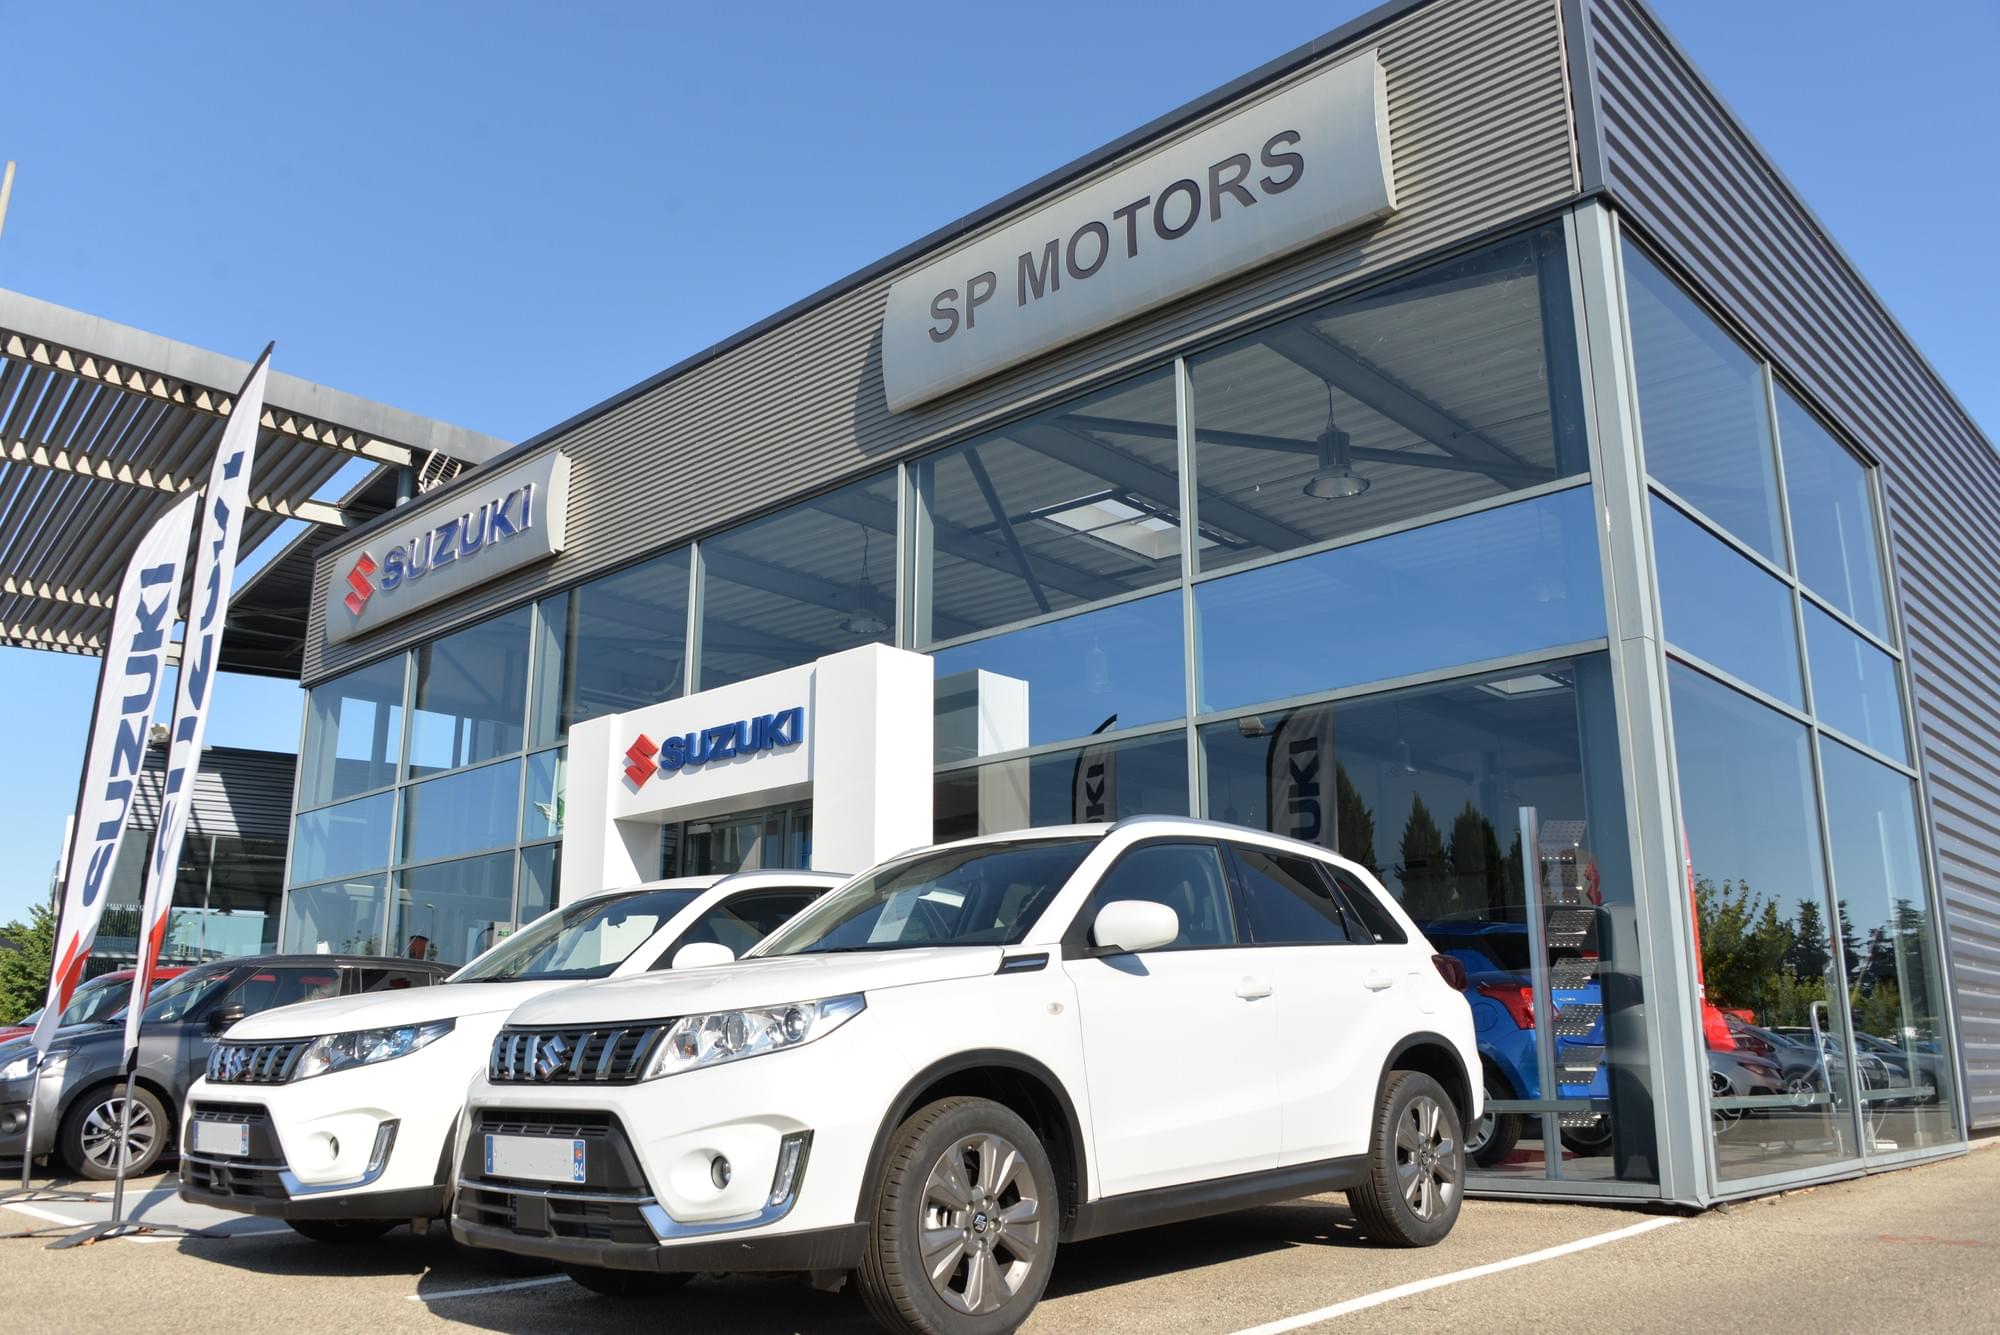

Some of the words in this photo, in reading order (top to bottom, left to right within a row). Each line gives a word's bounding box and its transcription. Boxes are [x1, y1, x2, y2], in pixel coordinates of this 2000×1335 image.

[928, 271, 997, 343] SP
[1017, 129, 1305, 308] MOTORS
[380, 482, 536, 591] SUZUKI
[82, 563, 176, 907] SUZUKI
[659, 706, 804, 771] SUZUKI
[1086, 762, 1105, 822] KI
[1288, 736, 1321, 845] UKI
[574, 1162, 584, 1177] 84
